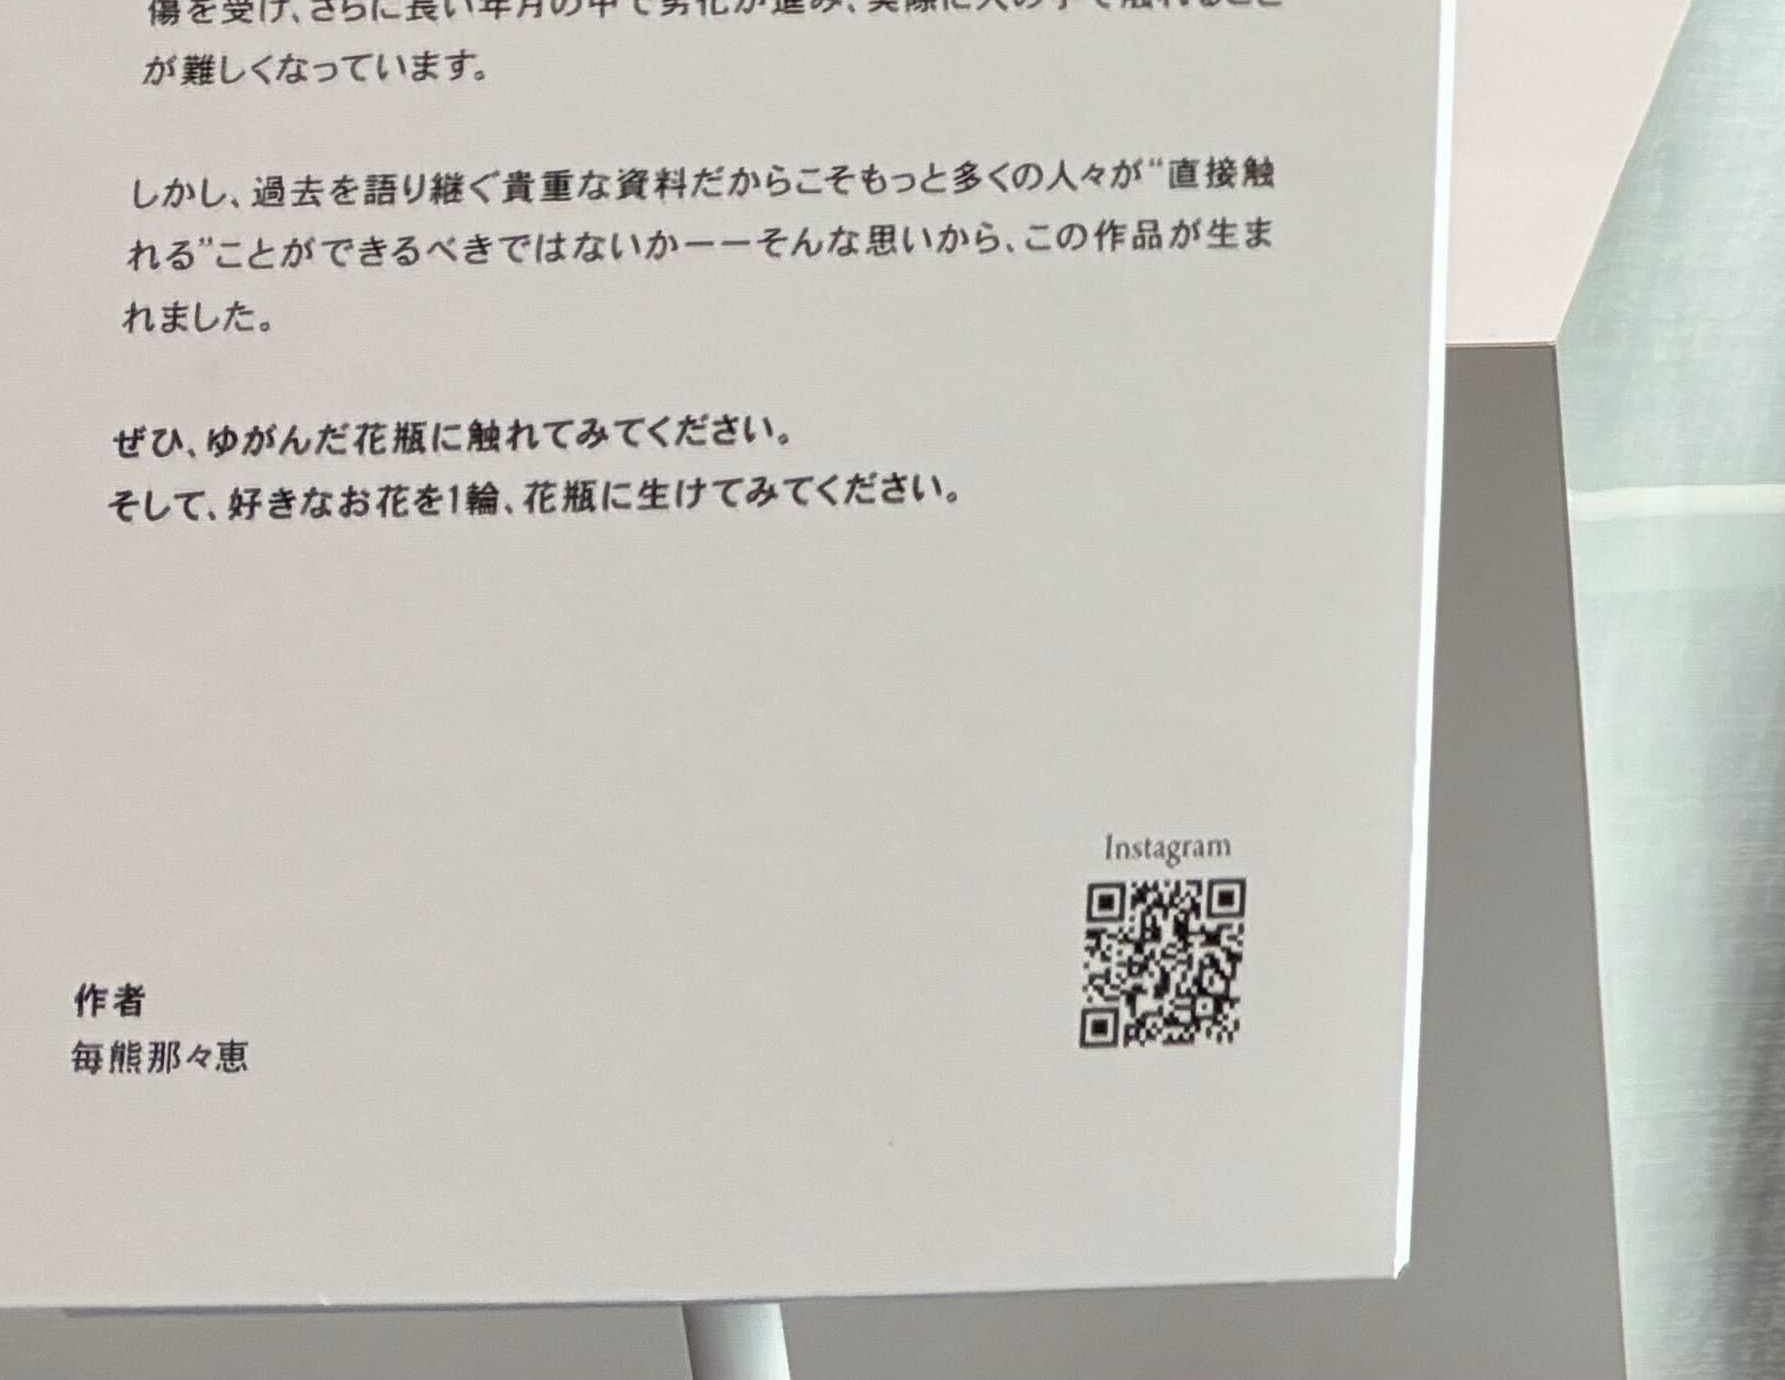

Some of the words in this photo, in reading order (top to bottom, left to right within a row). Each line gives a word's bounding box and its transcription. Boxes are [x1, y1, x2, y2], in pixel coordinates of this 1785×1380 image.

[142, 48, 485, 88] が難しくなっています。
[122, 300, 271, 334] れました。
[113, 413, 789, 459] ぜひ、ゆがんだ花瓶に触れてみてください。
[108, 472, 958, 524] そして、好きなお花を1輪、花瓶に生けてみてください。
[1105, 833, 1231, 869] Instagram
[74, 982, 146, 1018] 作者
